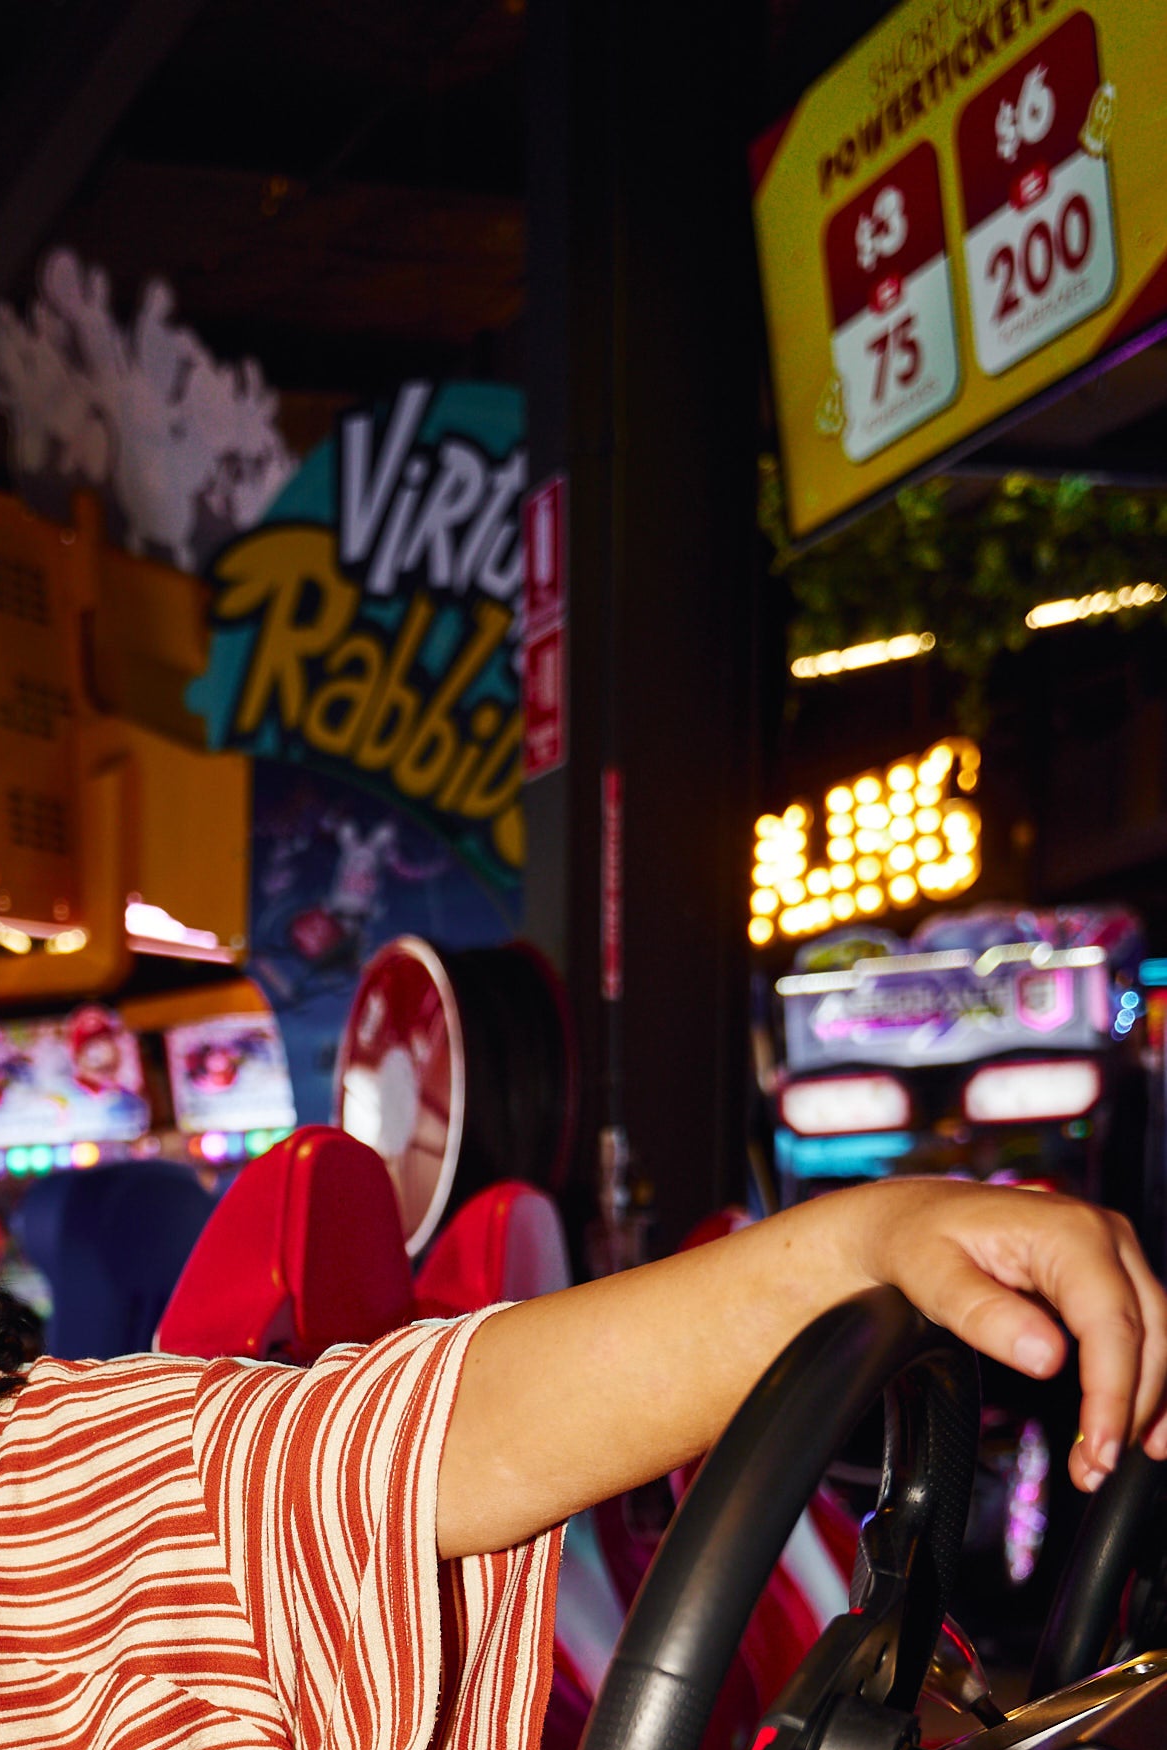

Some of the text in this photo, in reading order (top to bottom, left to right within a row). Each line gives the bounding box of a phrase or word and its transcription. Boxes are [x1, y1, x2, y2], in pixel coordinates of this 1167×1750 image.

[818, 0, 1054, 196] POWERTICKET
[994, 64, 1055, 163] $6
[855, 186, 908, 273] $3
[987, 194, 1092, 323] 200
[866, 314, 922, 404] 75
